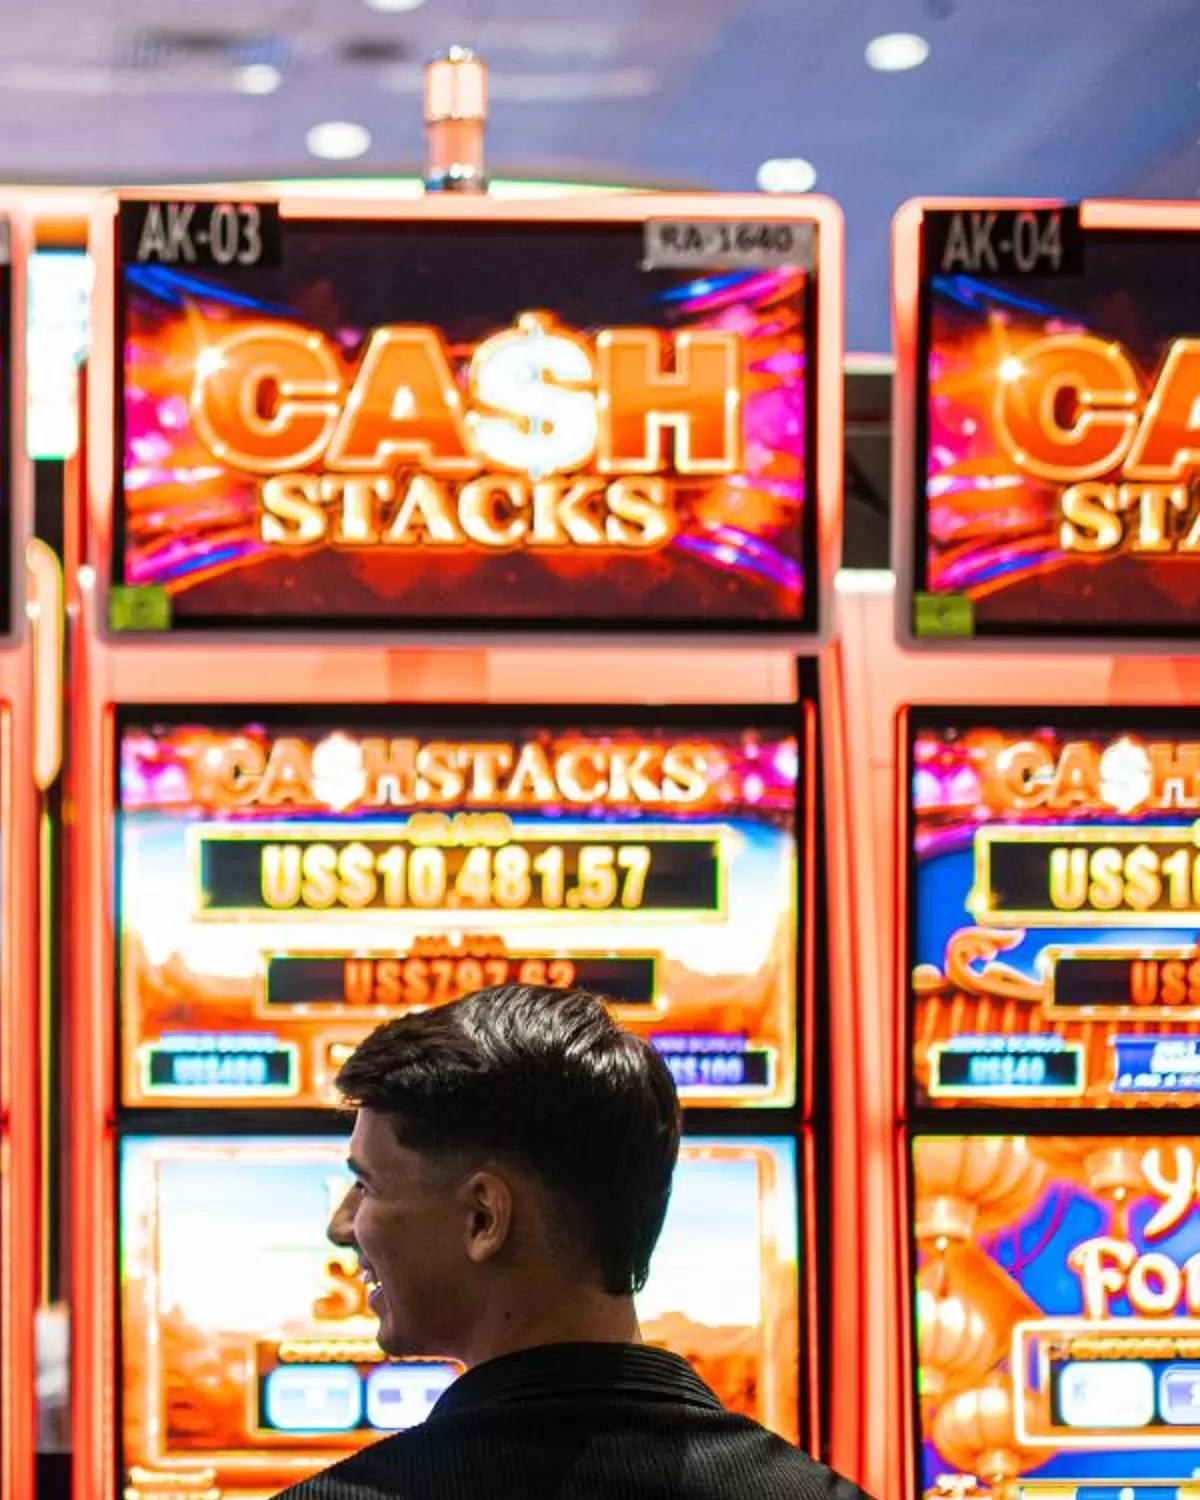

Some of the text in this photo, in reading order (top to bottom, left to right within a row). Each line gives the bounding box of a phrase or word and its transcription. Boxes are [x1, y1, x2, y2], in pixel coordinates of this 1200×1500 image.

[136, 203, 263, 265] AK-03
[942, 212, 1064, 271] AK-04
[260, 474, 669, 549] STACKS
[413, 742, 712, 804] STACKS
[1050, 845, 1200, 911] US$1
